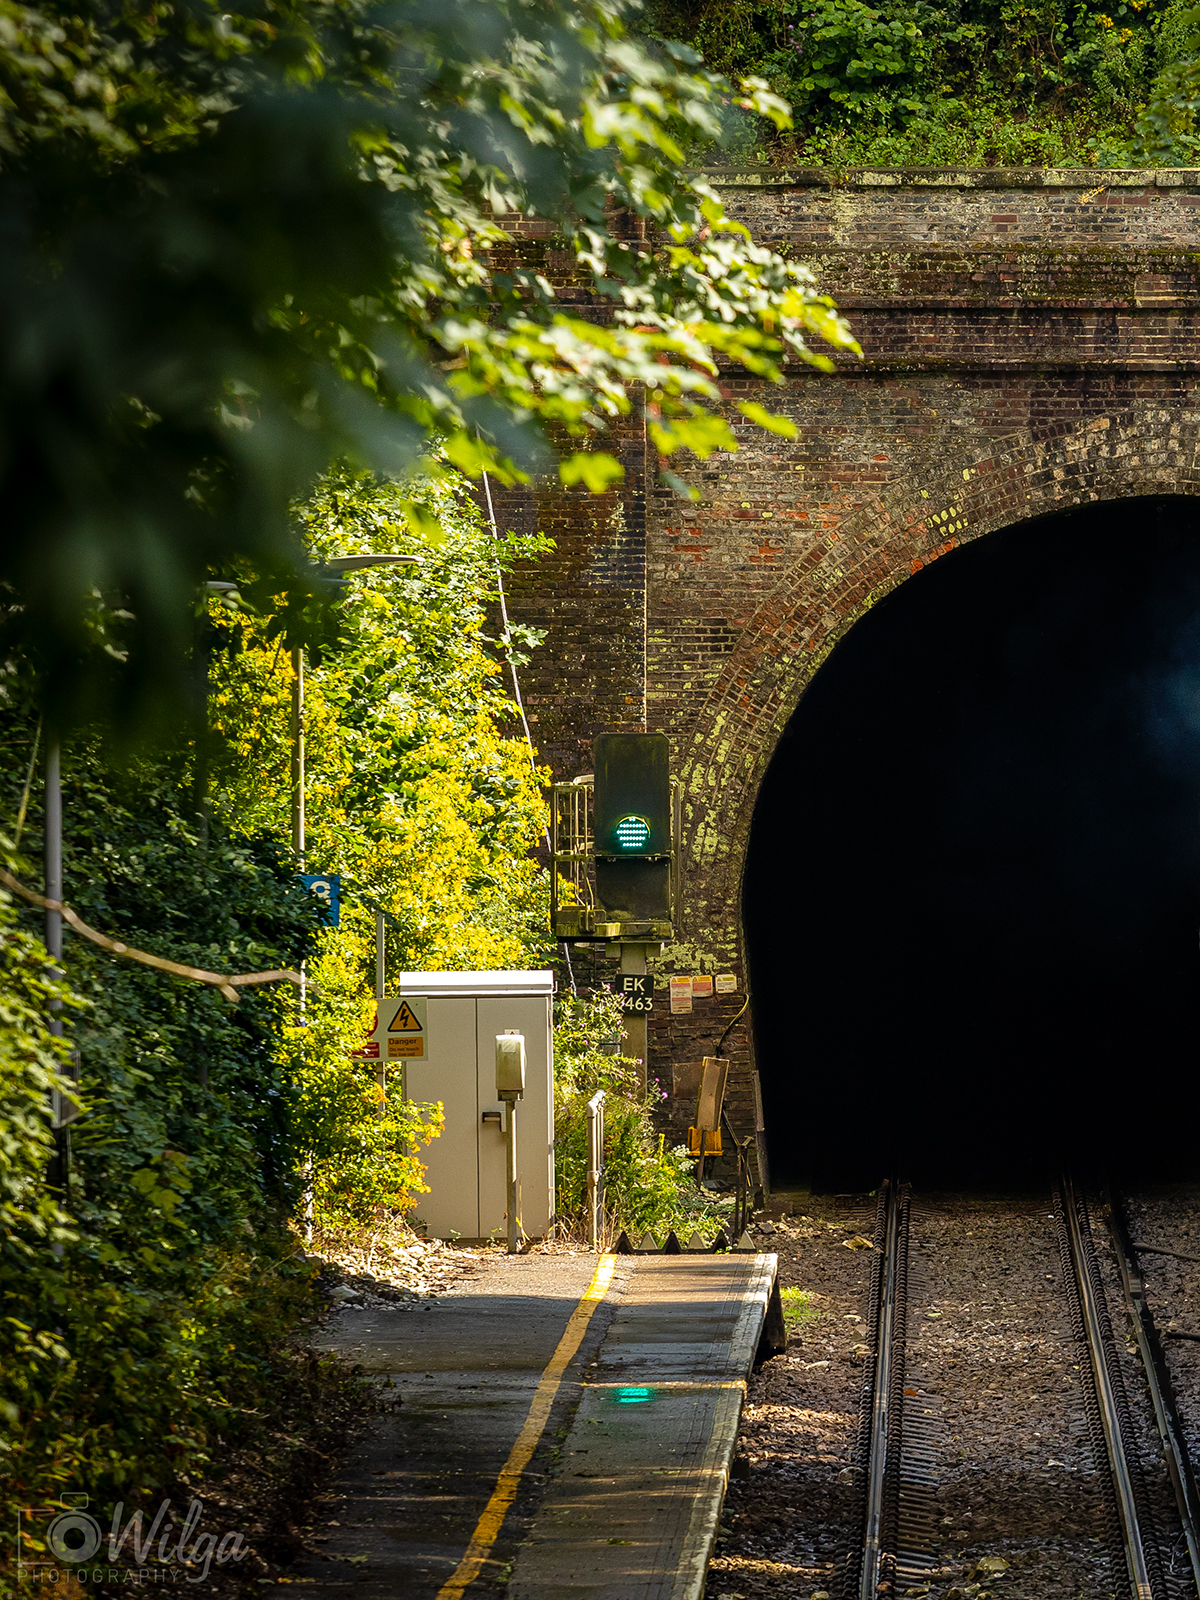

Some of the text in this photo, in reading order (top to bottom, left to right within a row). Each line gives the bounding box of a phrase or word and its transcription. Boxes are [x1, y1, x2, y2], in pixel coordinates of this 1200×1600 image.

[623, 977, 645, 992] EK
[622, 996, 653, 1011] 463
[389, 1038, 417, 1046] Danger
